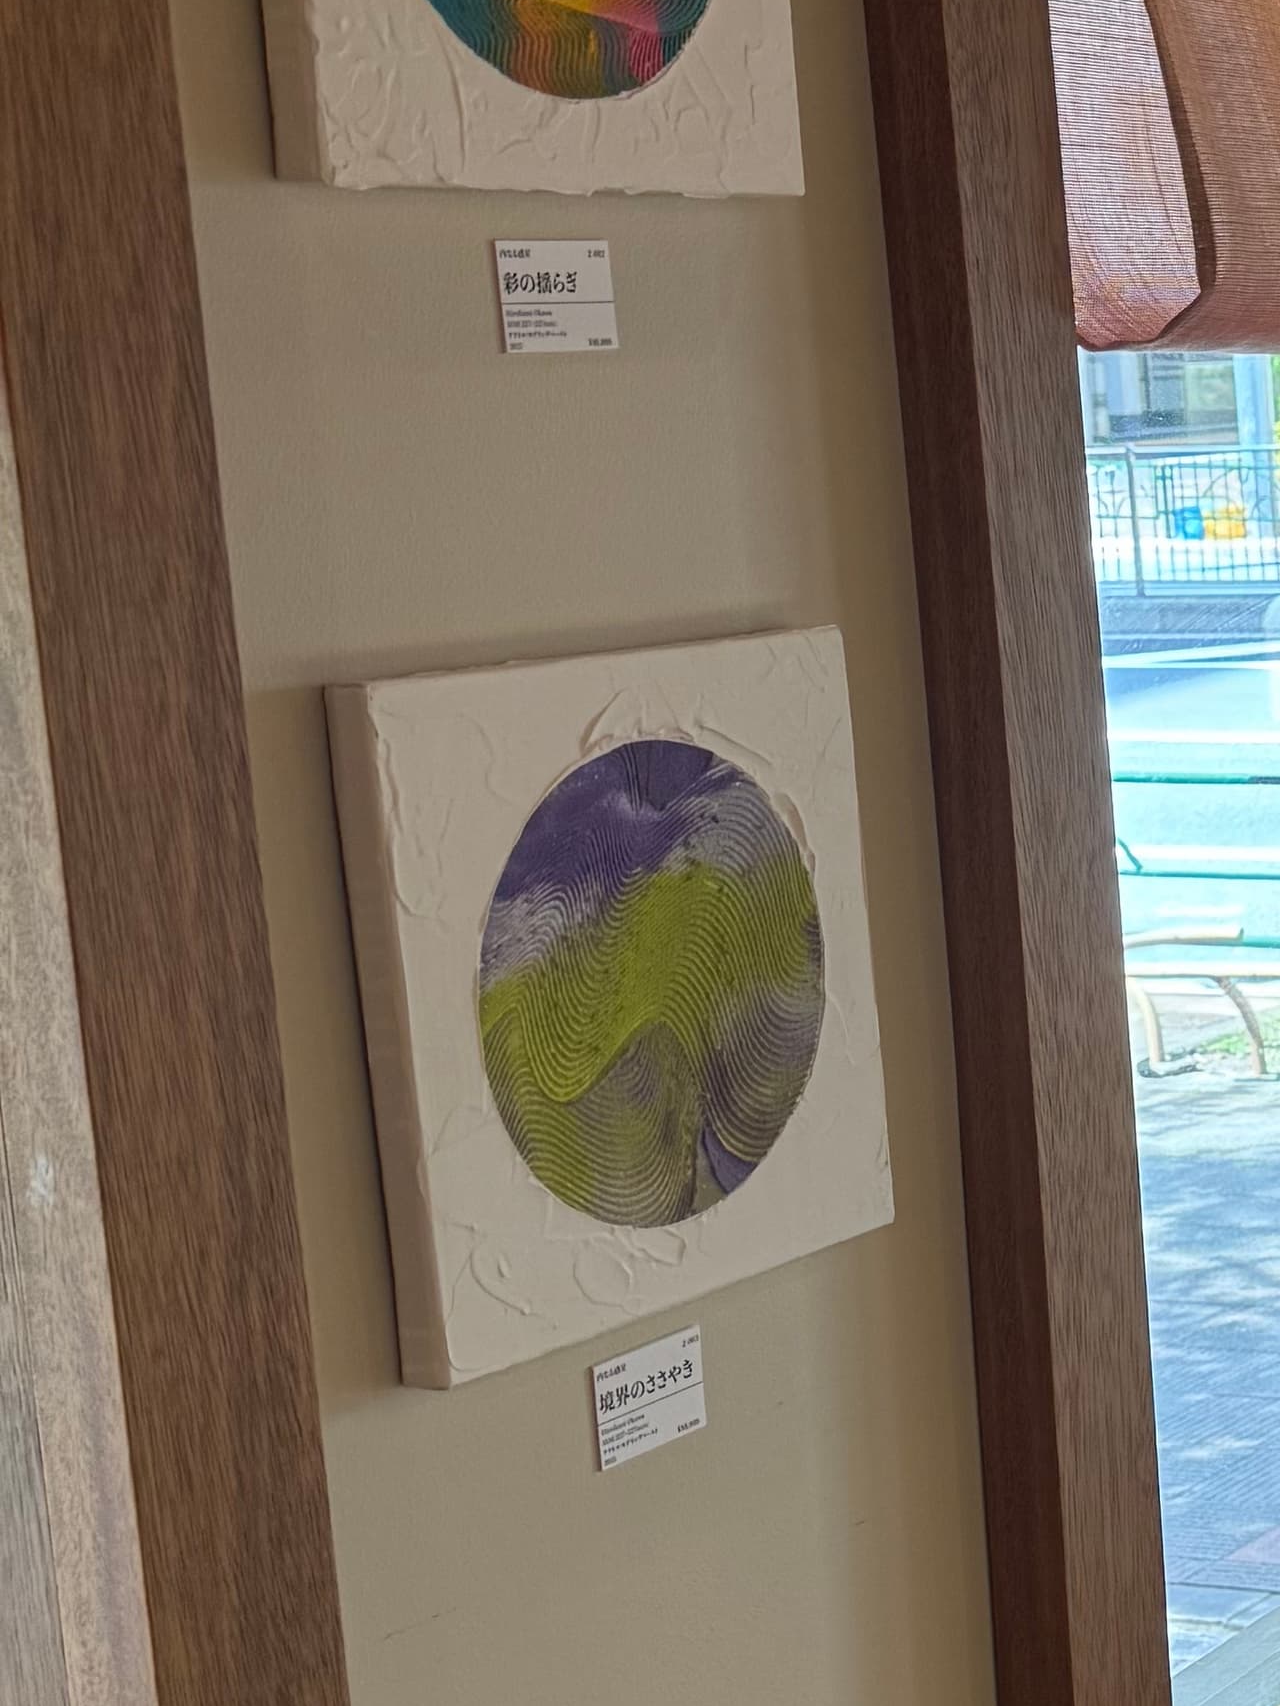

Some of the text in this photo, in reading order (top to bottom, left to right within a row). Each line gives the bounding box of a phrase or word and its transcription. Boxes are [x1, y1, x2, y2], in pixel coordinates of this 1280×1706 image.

[503, 271, 577, 295] 彩の揺らぎ
[599, 1359, 693, 1414] 境界のささやき
